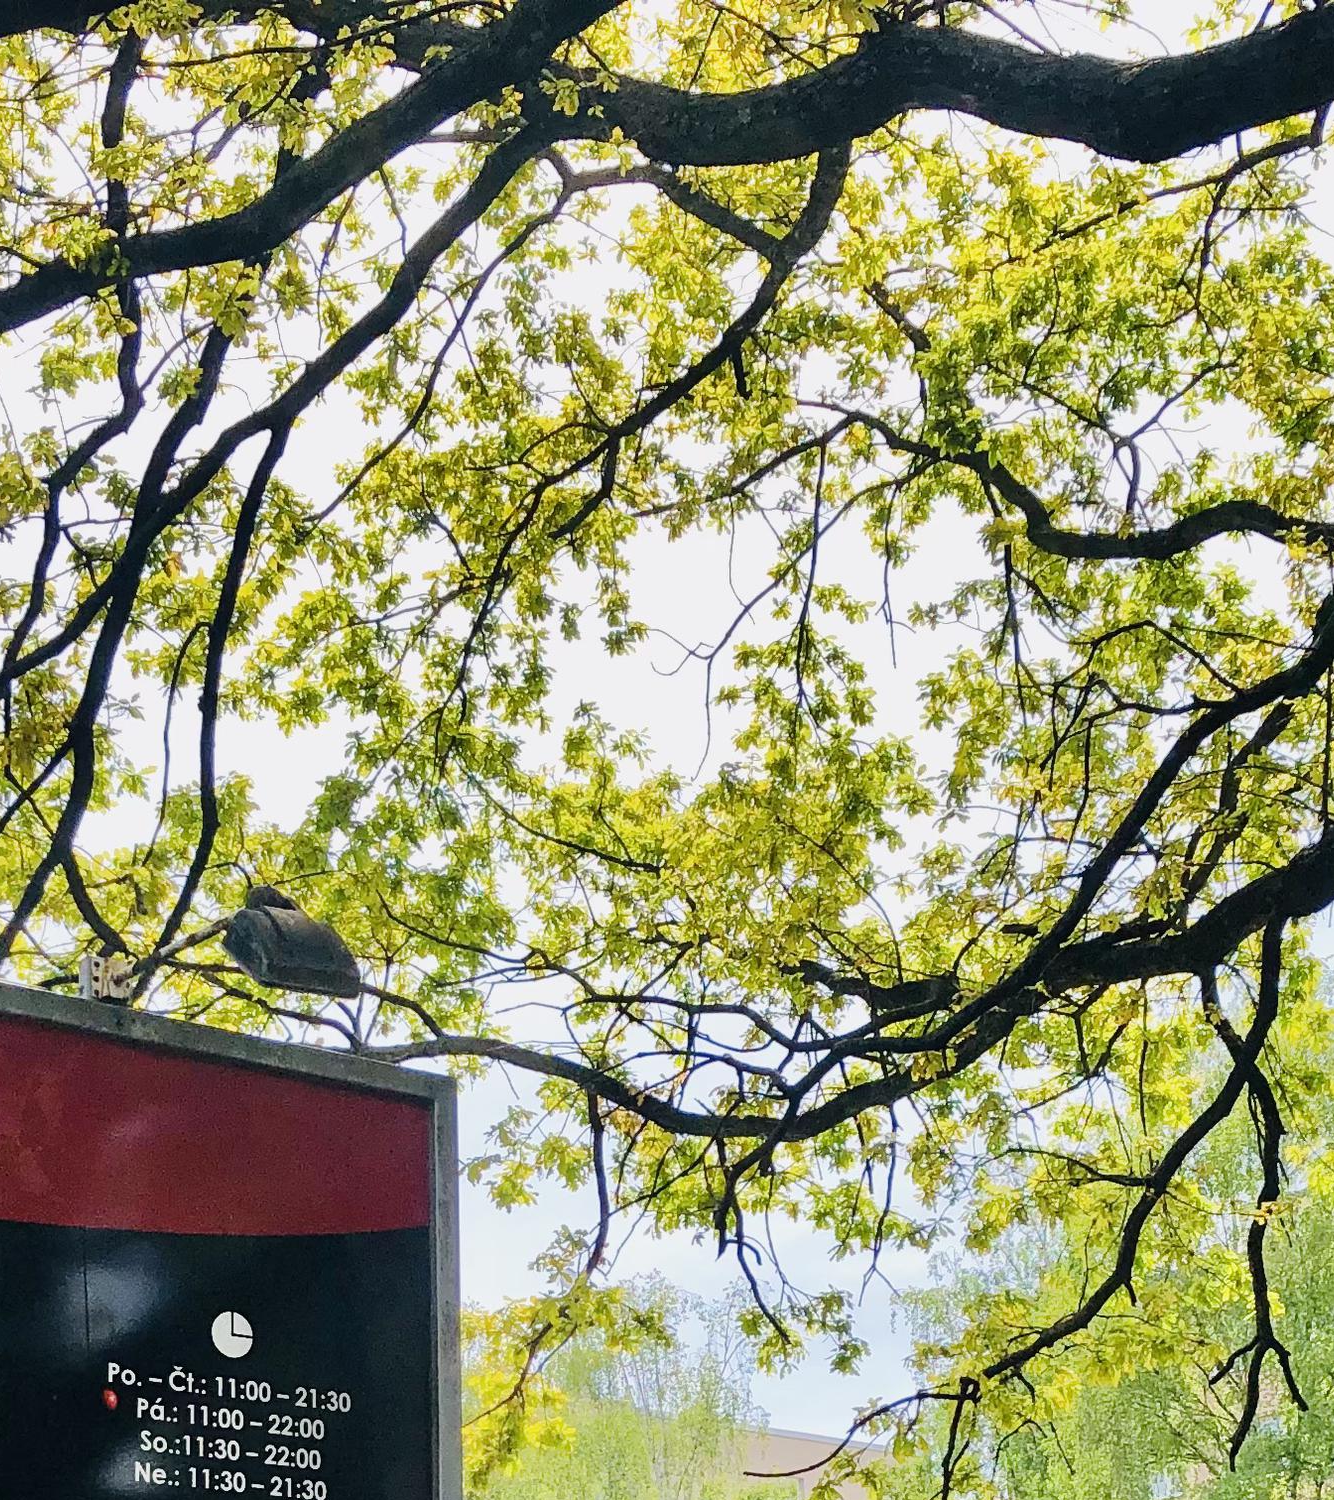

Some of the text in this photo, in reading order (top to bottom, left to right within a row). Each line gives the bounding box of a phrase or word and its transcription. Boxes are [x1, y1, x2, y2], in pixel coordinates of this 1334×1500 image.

[108, 1362, 142, 1387] Po.
[215, 1376, 272, 1403] 11:00
[295, 1386, 351, 1413] 21:30
[187, 1404, 244, 1430] 11:00
[267, 1414, 325, 1440] 22:00
[264, 1444, 322, 1470] 22:00
[134, 1460, 180, 1487] Ne.:
[188, 1466, 246, 1493] 11:30
[269, 1475, 327, 1500] 21:30
